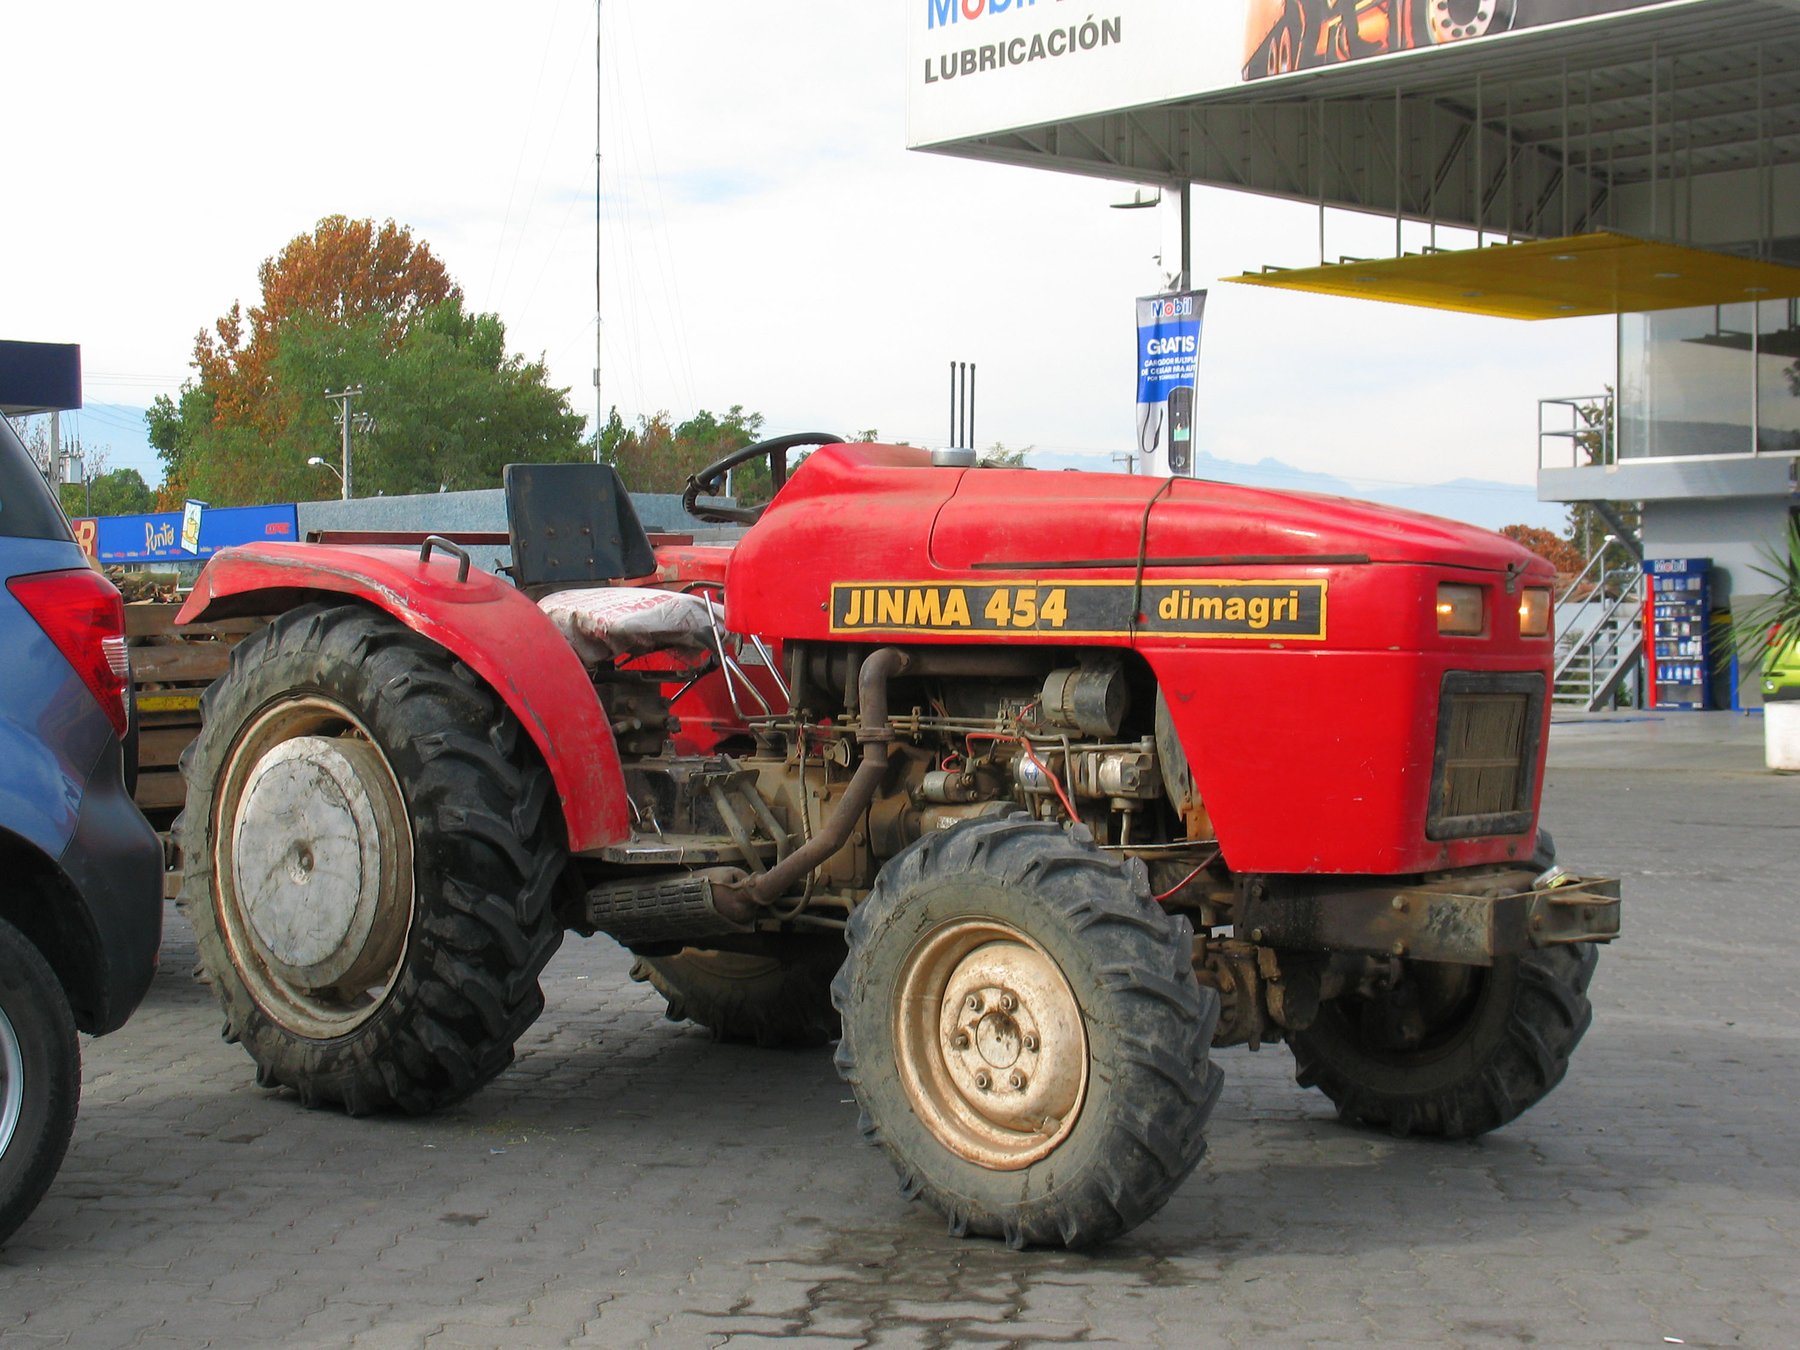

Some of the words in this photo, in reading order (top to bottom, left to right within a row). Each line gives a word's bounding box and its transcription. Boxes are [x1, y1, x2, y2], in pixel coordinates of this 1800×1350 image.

[925, 13, 1121, 84] LUBRICACIÓN
[1151, 297, 1192, 318] Mobil
[1147, 335, 1195, 355] GRATIS
[843, 588, 972, 626] JINMA
[984, 588, 1068, 628] 454
[1158, 589, 1299, 629] dimagri
